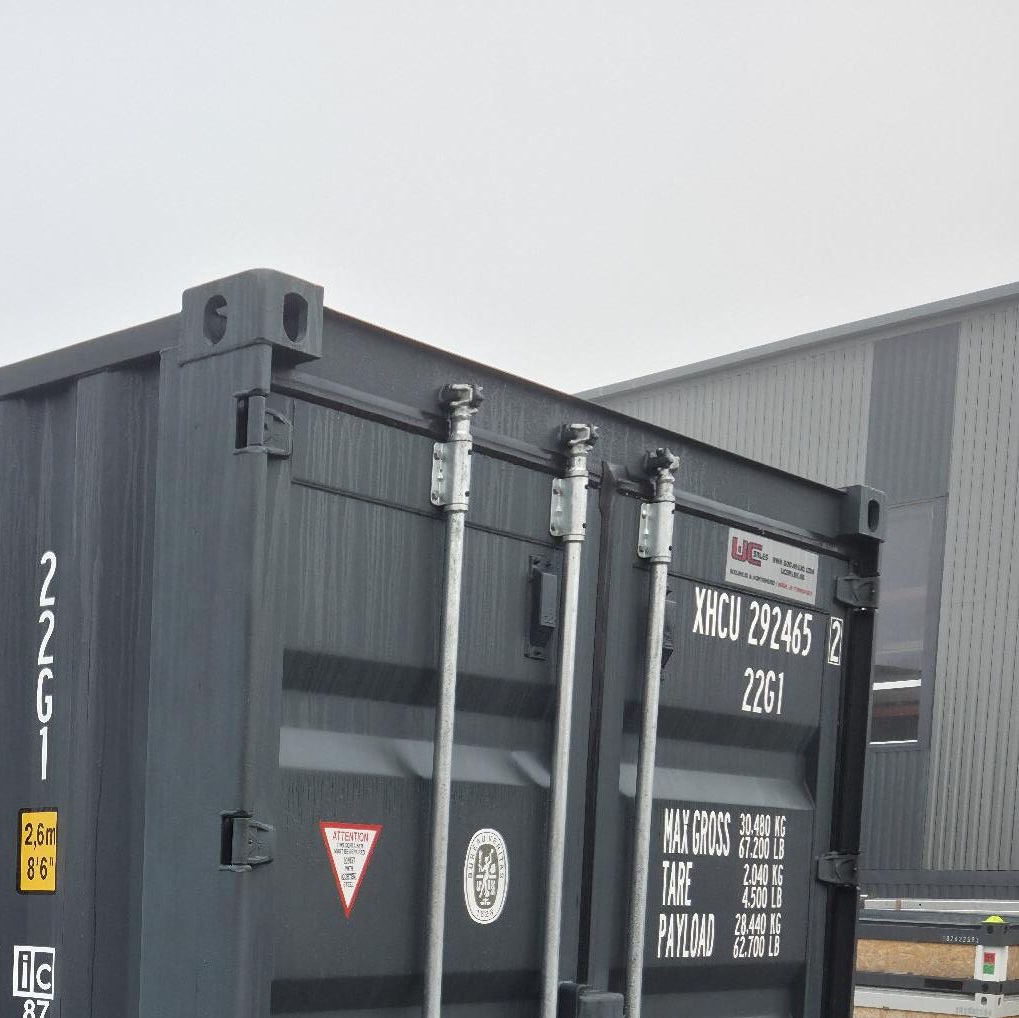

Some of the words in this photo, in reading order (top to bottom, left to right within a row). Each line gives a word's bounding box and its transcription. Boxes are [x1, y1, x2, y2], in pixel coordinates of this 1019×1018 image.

[692, 586, 741, 641] XHCU
[747, 600, 814, 657] 292465
[829, 620, 842, 663] 2
[36, 551, 57, 781] 22G1
[741, 667, 785, 715] 22G1
[24, 822, 56, 850] 2,6m
[332, 831, 369, 843] ATTENTION
[663, 808, 690, 854] MAX
[692, 809, 732, 857] GROSS
[774, 815, 787, 837] KG
[773, 837, 785, 860] LB
[662, 860, 693, 906] TARE
[772, 864, 784, 886] KG
[771, 886, 783, 909] LB
[657, 912, 715, 959] PAYLOAD
[769, 912, 782, 935] KG
[768, 935, 780, 957] LB
